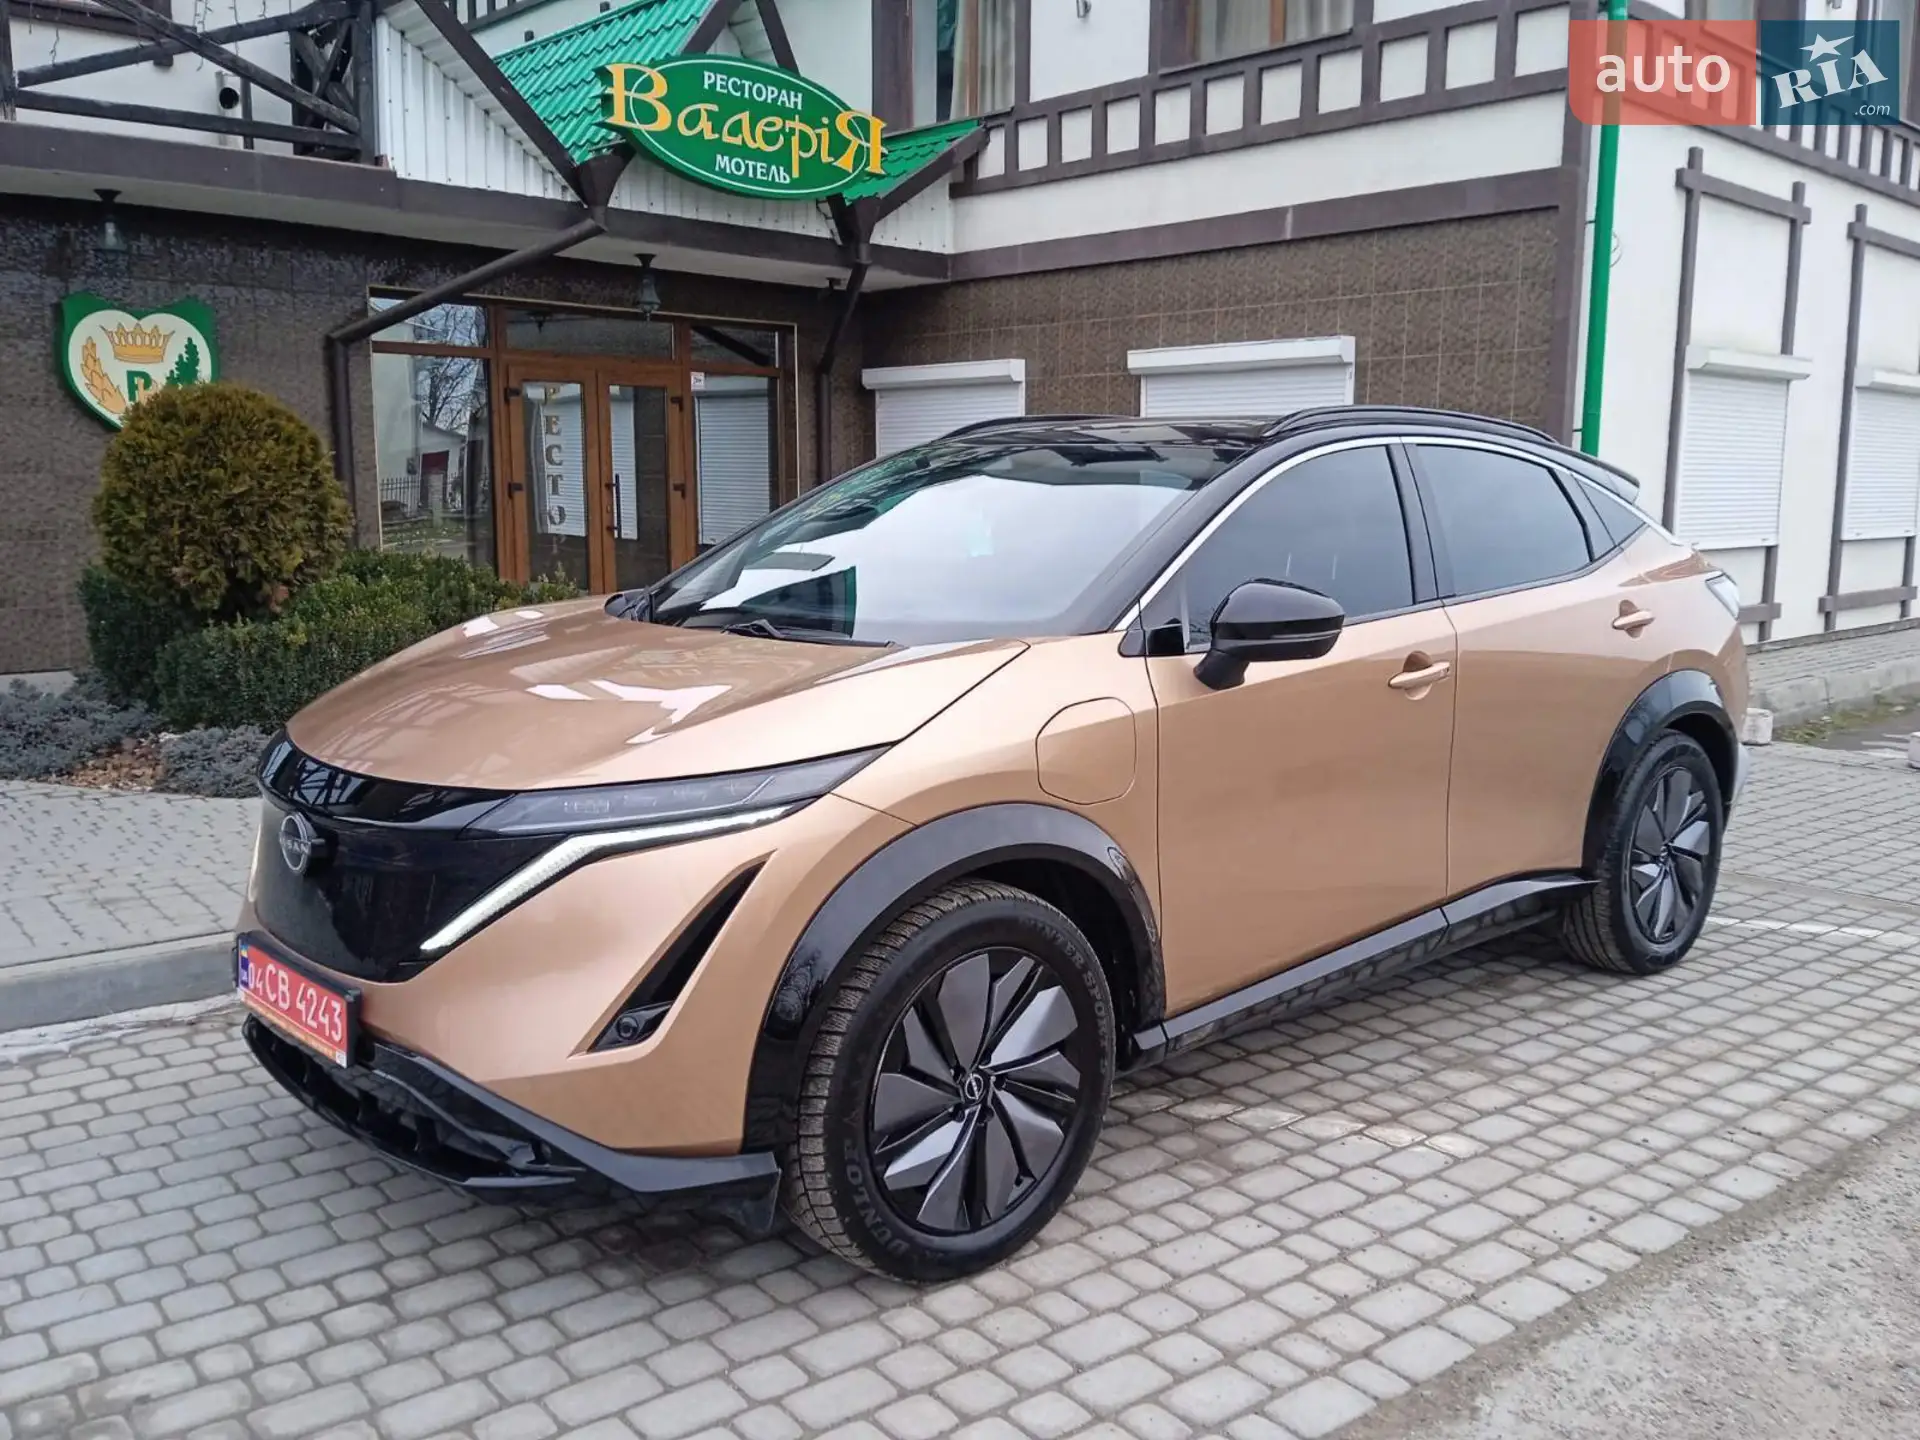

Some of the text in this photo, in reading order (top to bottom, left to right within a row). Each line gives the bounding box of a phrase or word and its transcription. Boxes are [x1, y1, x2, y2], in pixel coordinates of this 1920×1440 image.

[703, 71, 803, 110] РЕСТОРАН
[715, 154, 791, 184] МОТЕЛЬ
[296, 982, 342, 1042] 4243
